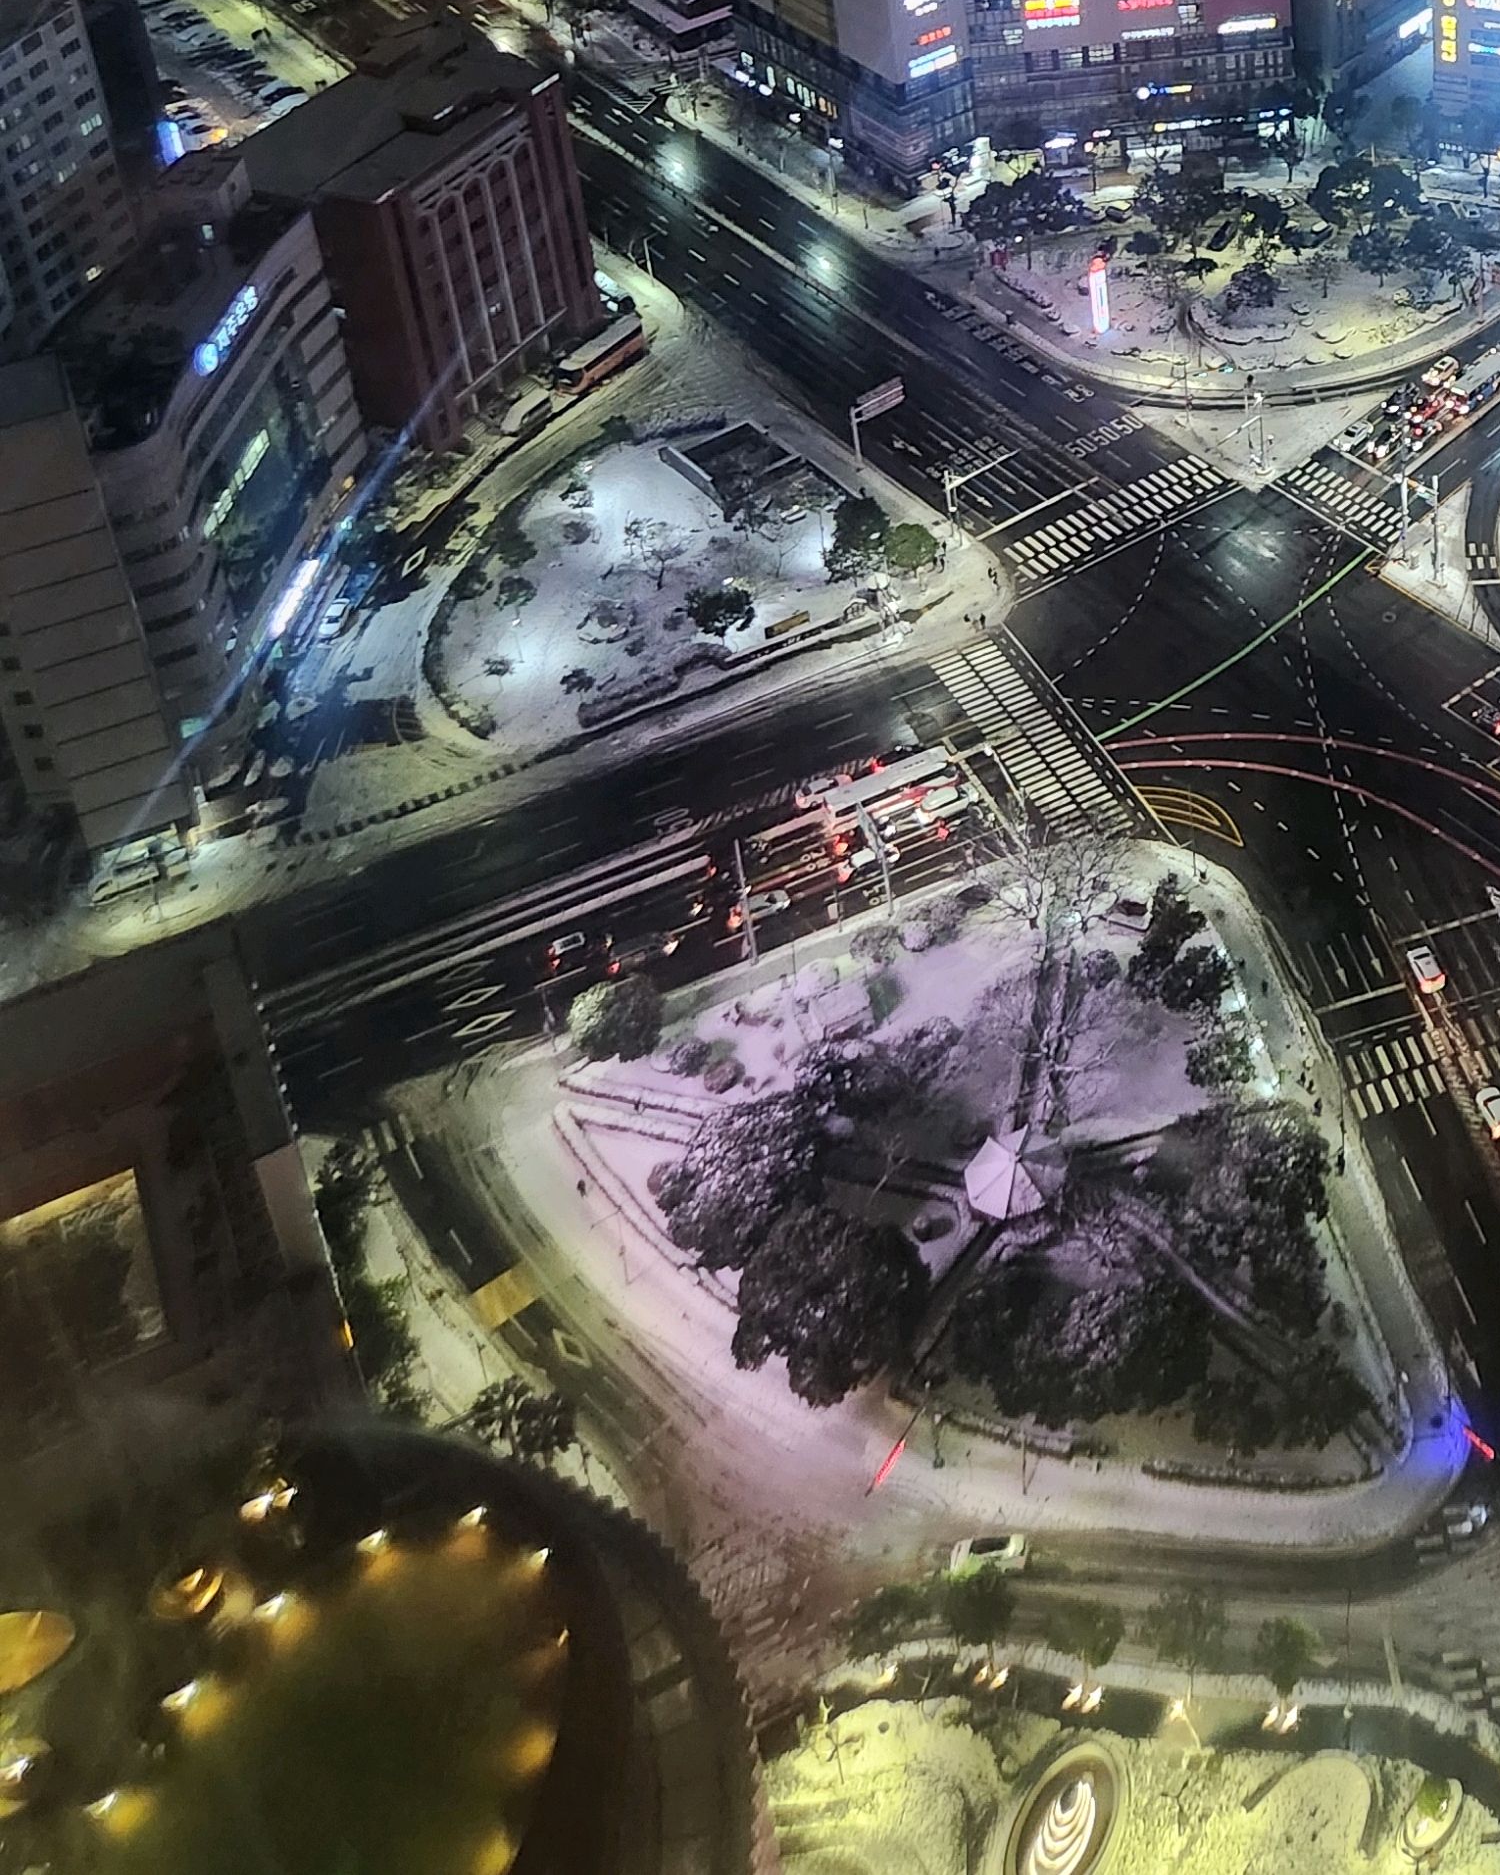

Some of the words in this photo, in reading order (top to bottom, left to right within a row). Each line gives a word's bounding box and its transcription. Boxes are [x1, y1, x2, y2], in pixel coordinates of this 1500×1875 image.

[1065, 437, 1098, 457] 50
[1087, 426, 1121, 446] 50
[1110, 413, 1144, 434] 50
